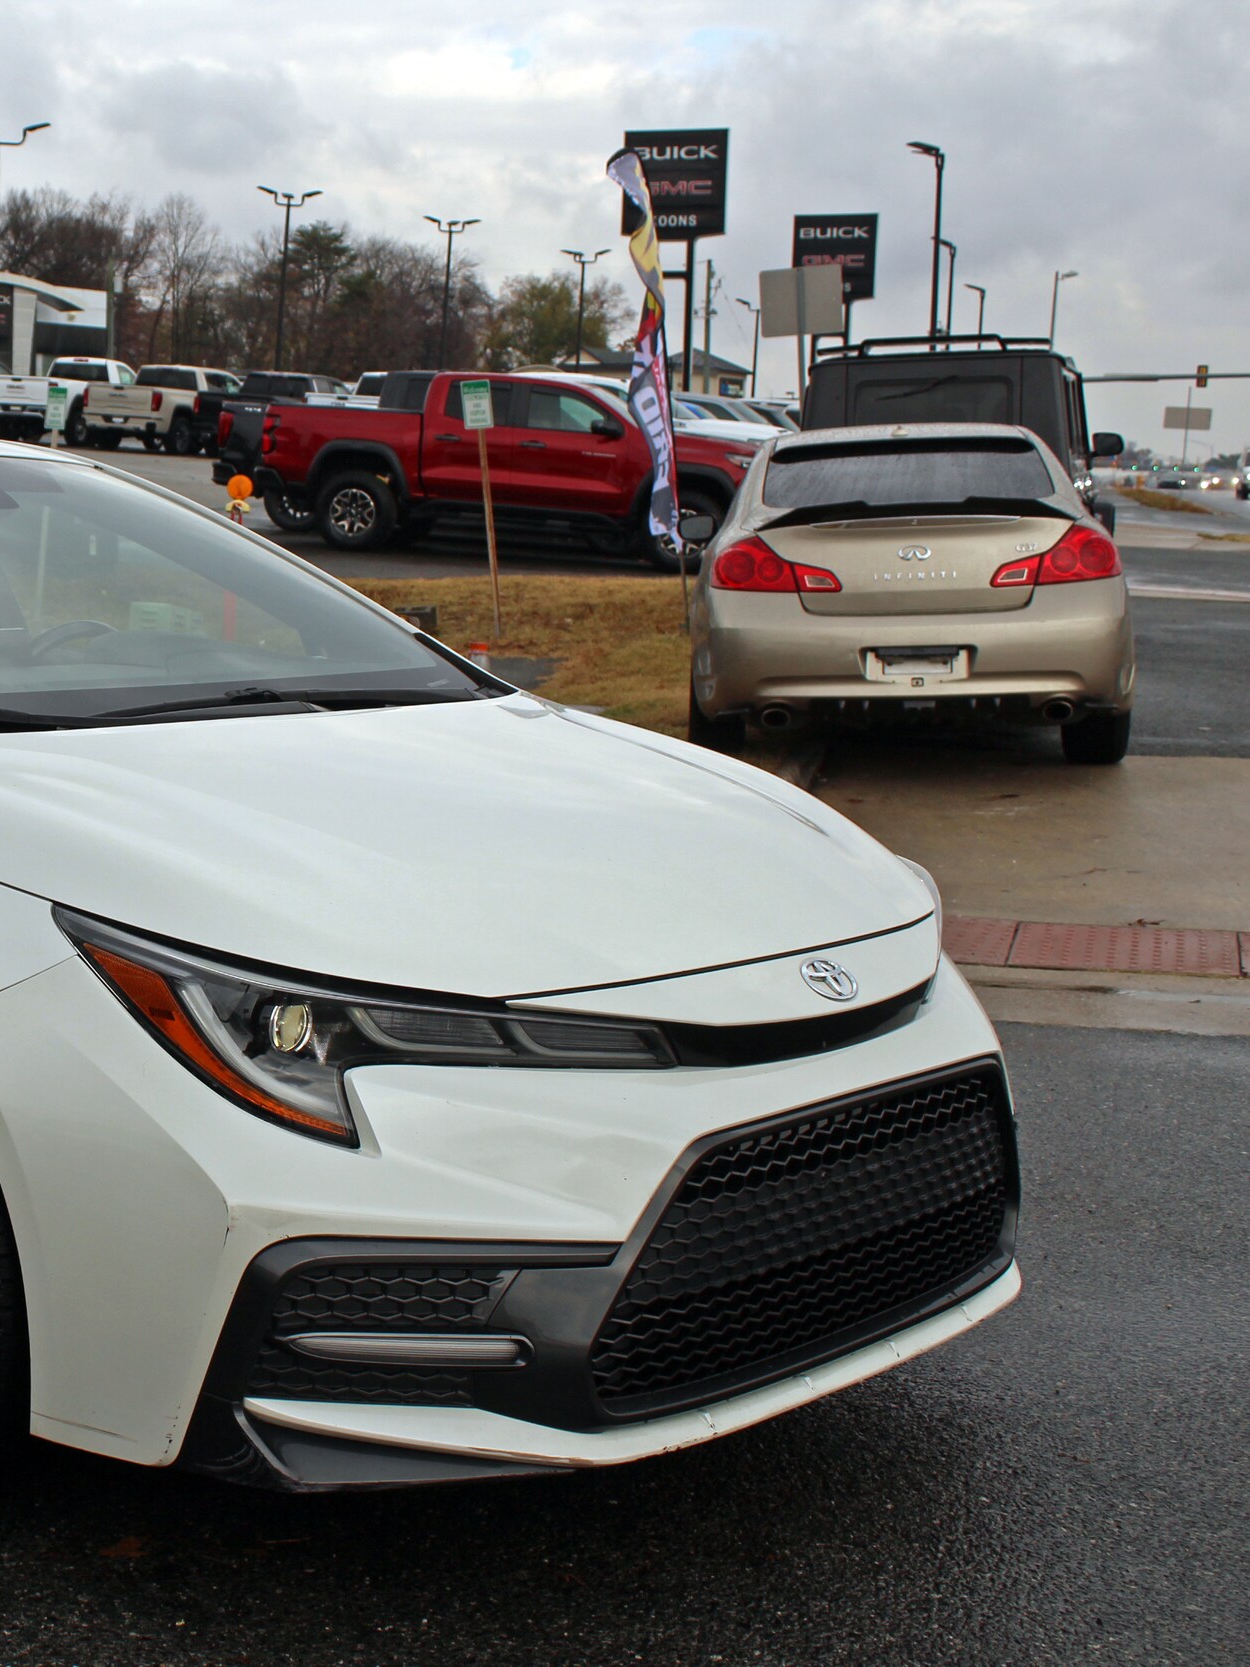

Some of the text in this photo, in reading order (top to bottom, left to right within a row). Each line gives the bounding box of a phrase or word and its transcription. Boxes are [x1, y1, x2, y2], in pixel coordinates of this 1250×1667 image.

[634, 145, 718, 159] BUICK
[654, 214, 697, 227] OONS
[799, 226, 869, 239] BUICK
[874, 570, 957, 580] INFINITI
